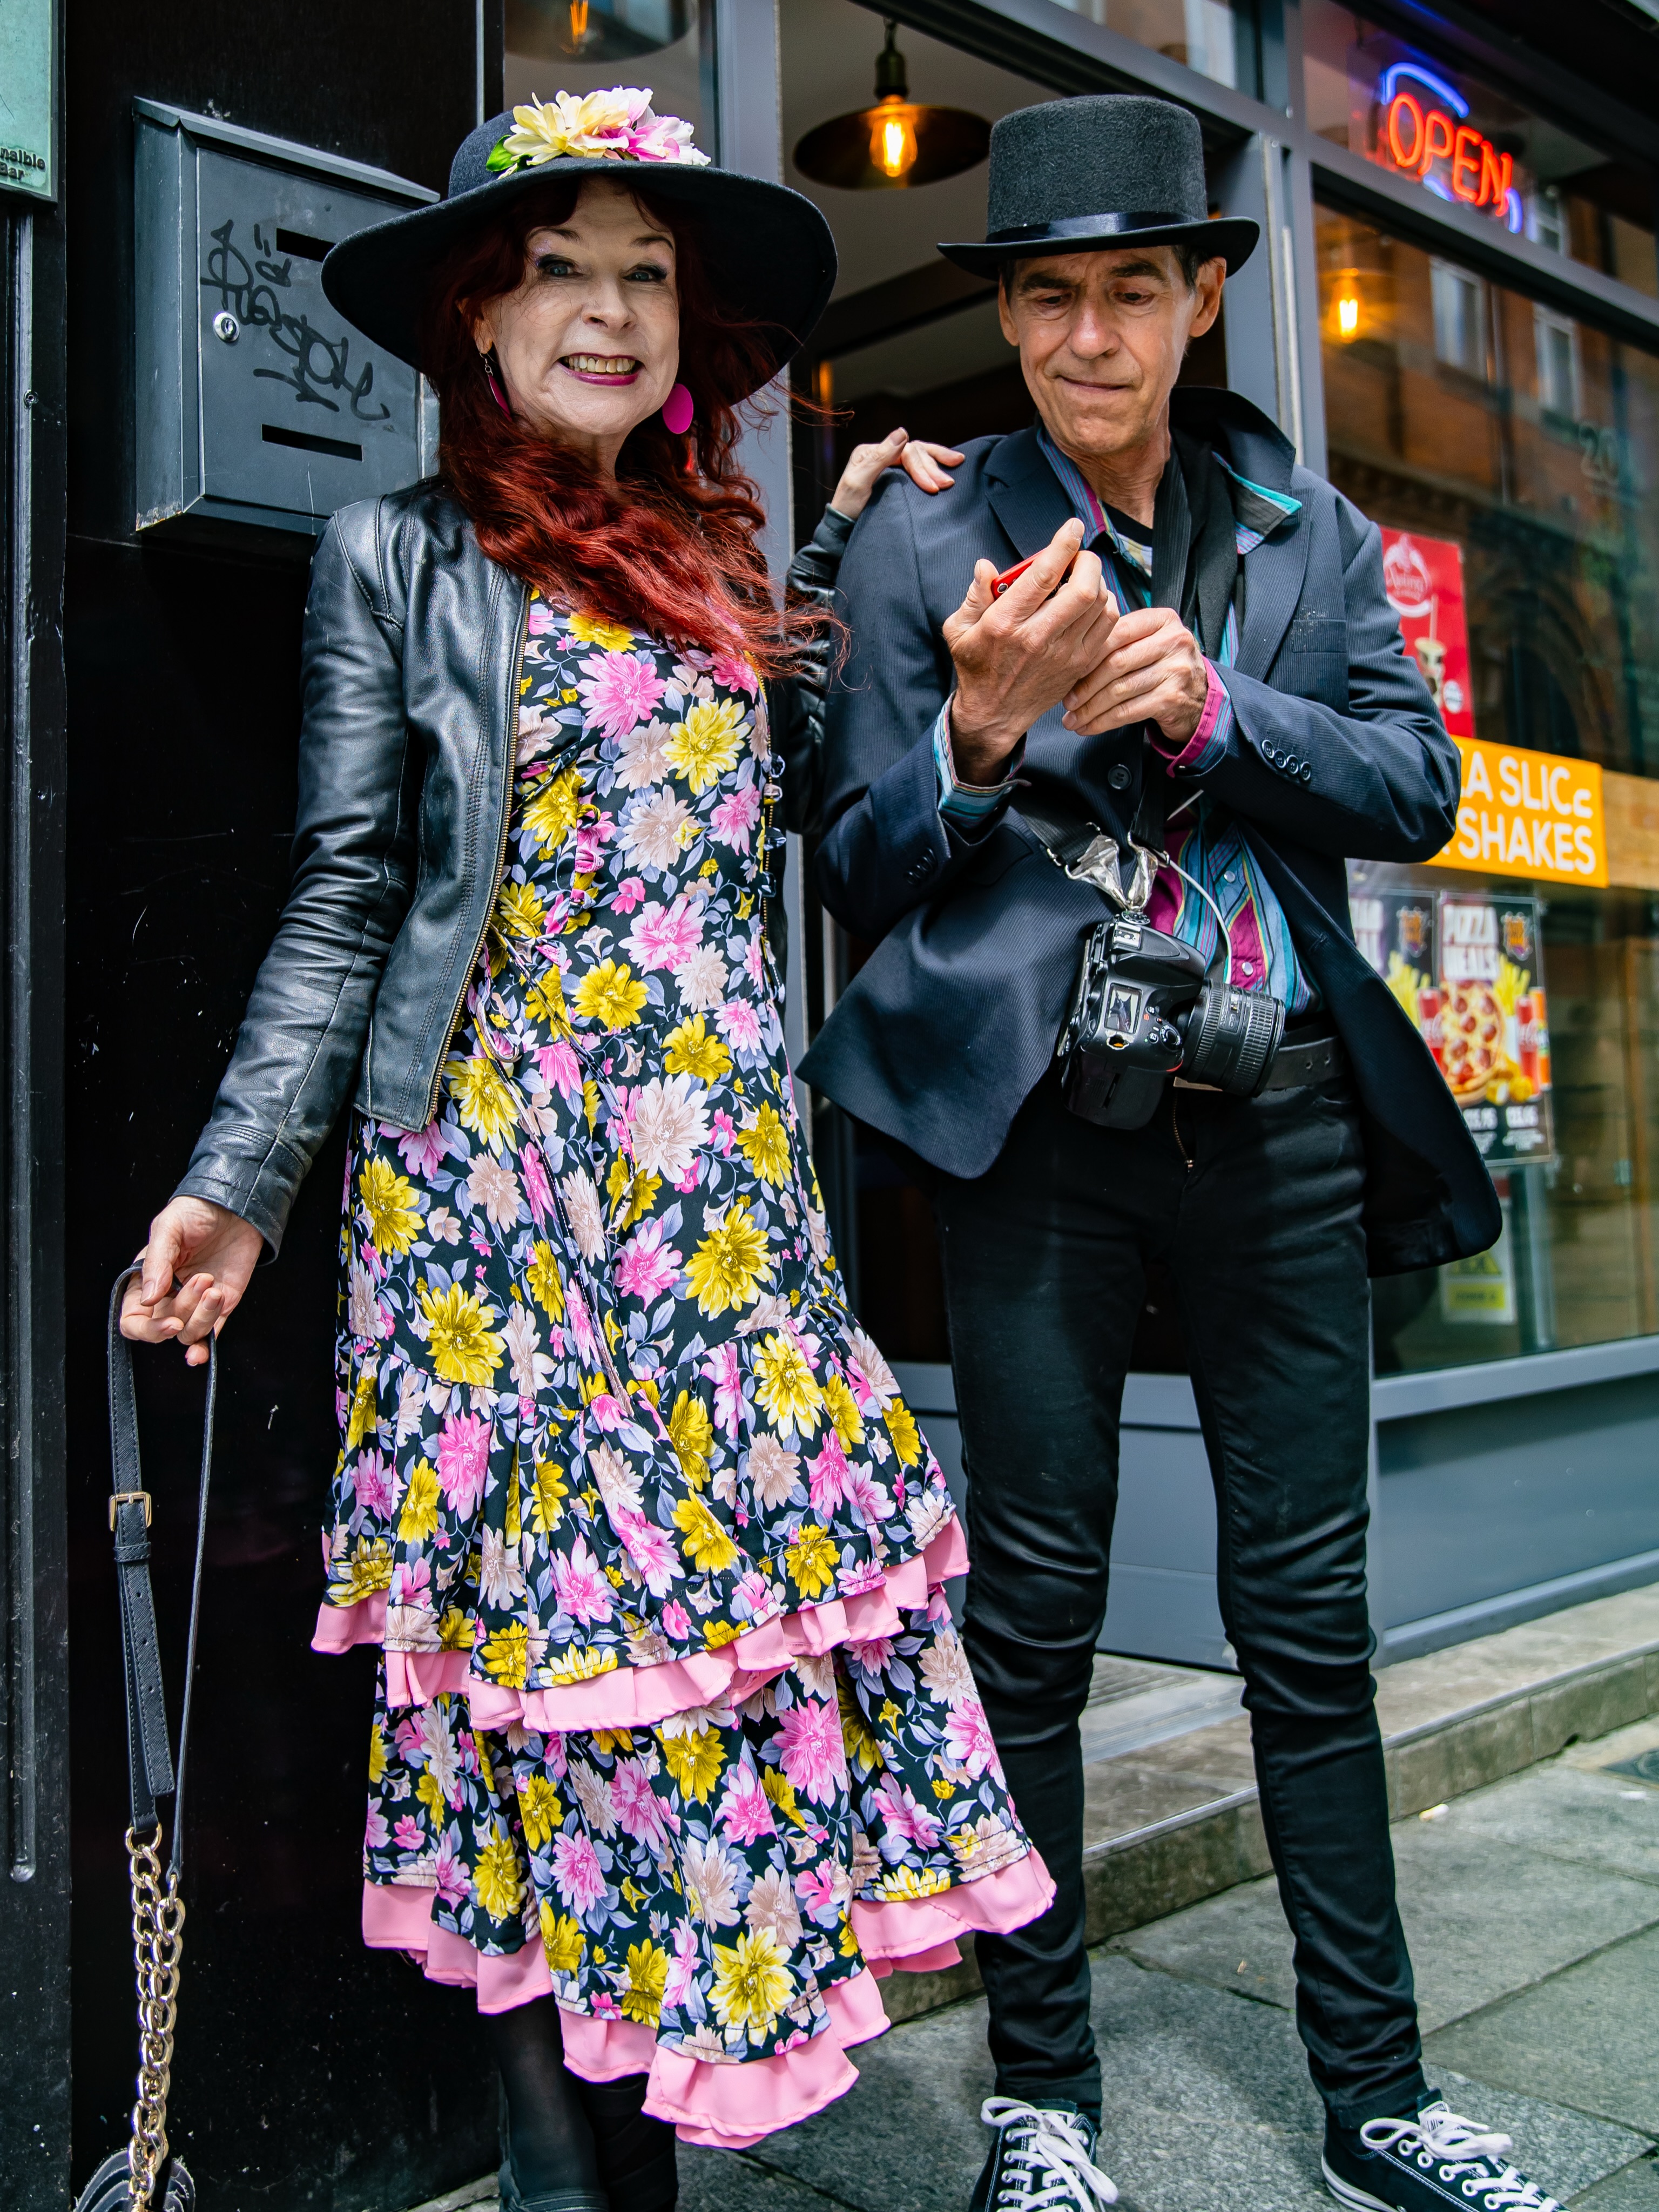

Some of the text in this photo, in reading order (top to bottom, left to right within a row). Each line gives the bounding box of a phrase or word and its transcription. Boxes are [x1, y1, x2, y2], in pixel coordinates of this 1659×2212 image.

[0, 161, 25, 180] Bar
[1388, 92, 1513, 217] OPEN
[1456, 806, 1596, 875] SHAKES
[1443, 904, 1498, 944] PIZZA
[1443, 945, 1499, 980] MEALS
